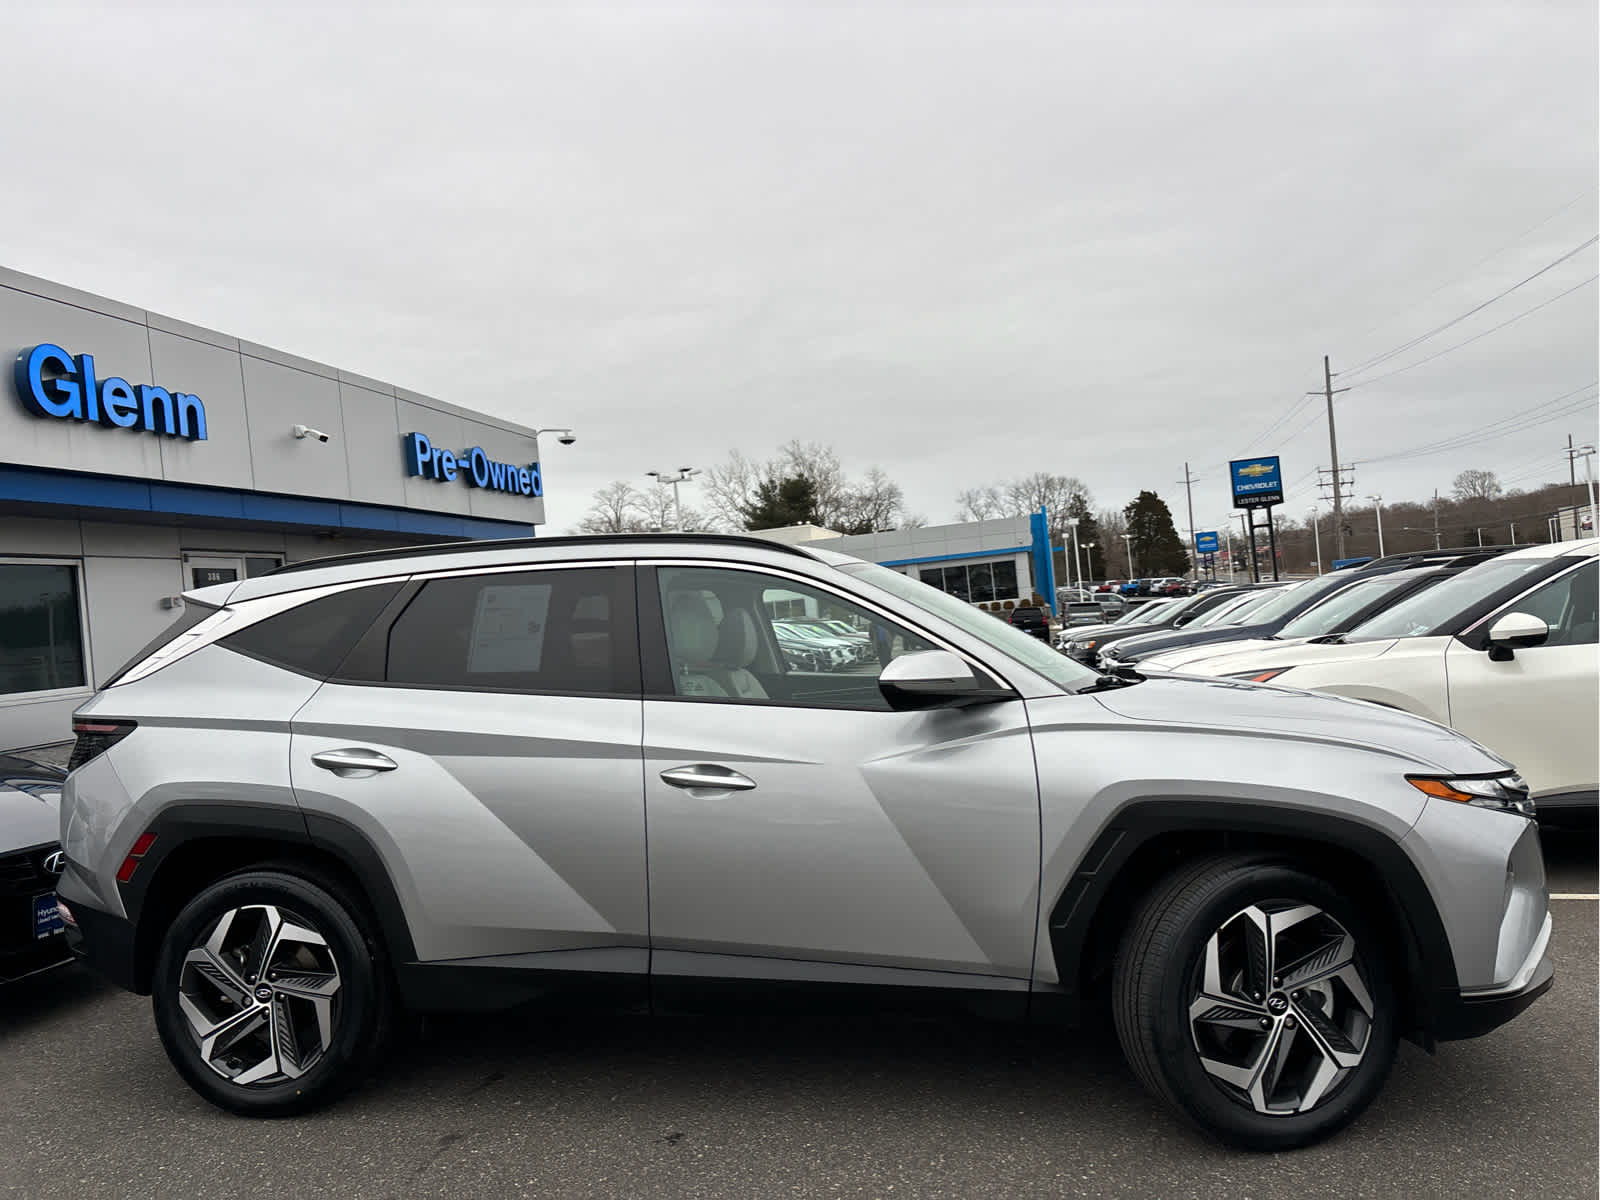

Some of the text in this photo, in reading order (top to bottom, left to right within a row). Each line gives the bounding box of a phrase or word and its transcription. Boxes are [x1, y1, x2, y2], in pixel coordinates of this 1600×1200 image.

[20, 343, 208, 440] Glenn
[410, 432, 543, 497] Pre-Owned
[1236, 481, 1278, 491] CHEVROLET
[1237, 497, 1259, 505] LESTER
